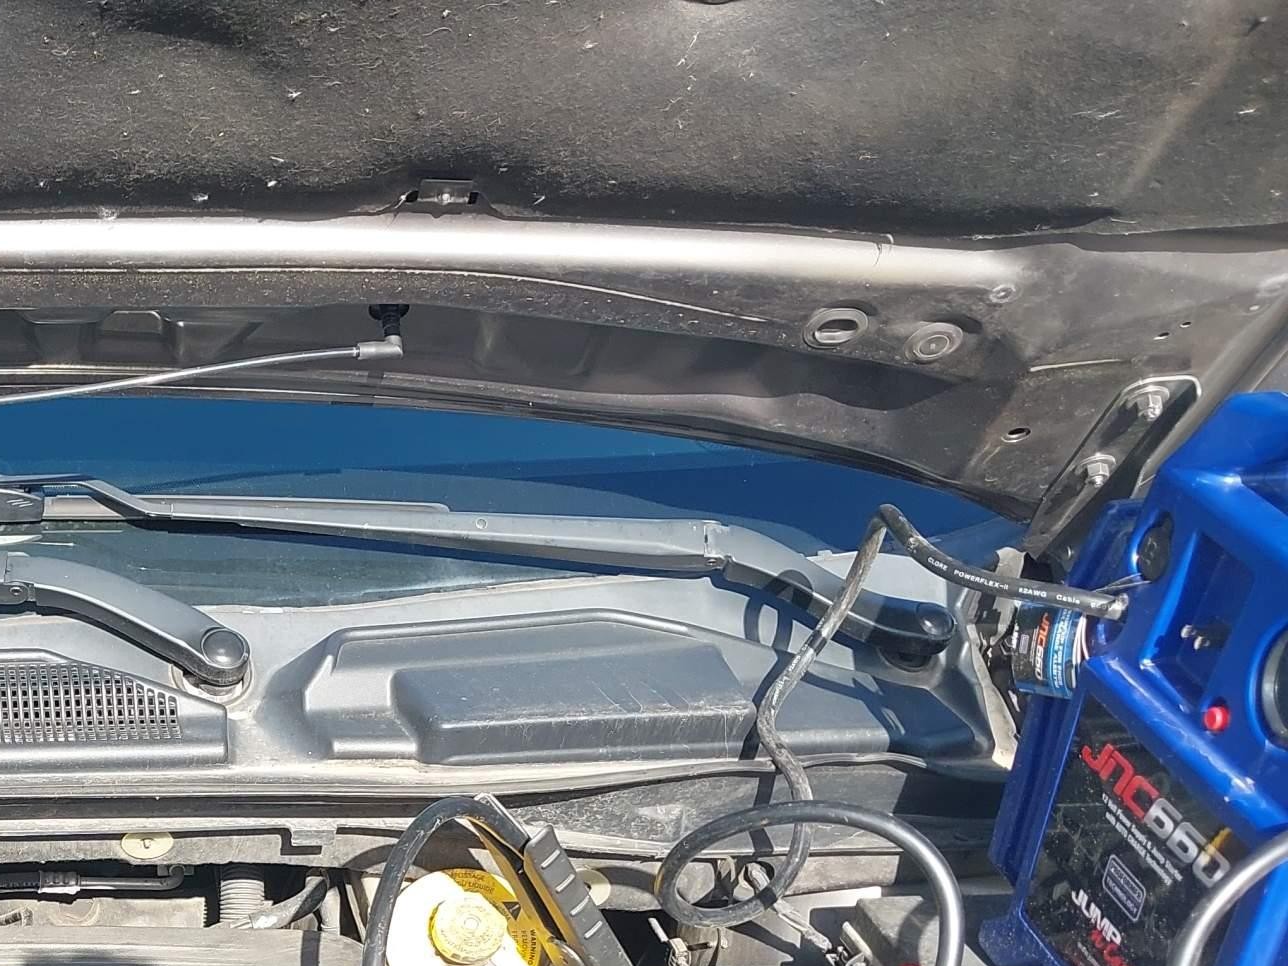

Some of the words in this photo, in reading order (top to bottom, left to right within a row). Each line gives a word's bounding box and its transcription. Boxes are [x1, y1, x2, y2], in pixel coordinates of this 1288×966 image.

[927, 556, 949, 572] CLORE
[1080, 742, 1231, 889] JNC660
[1071, 888, 1122, 946] JUMP
